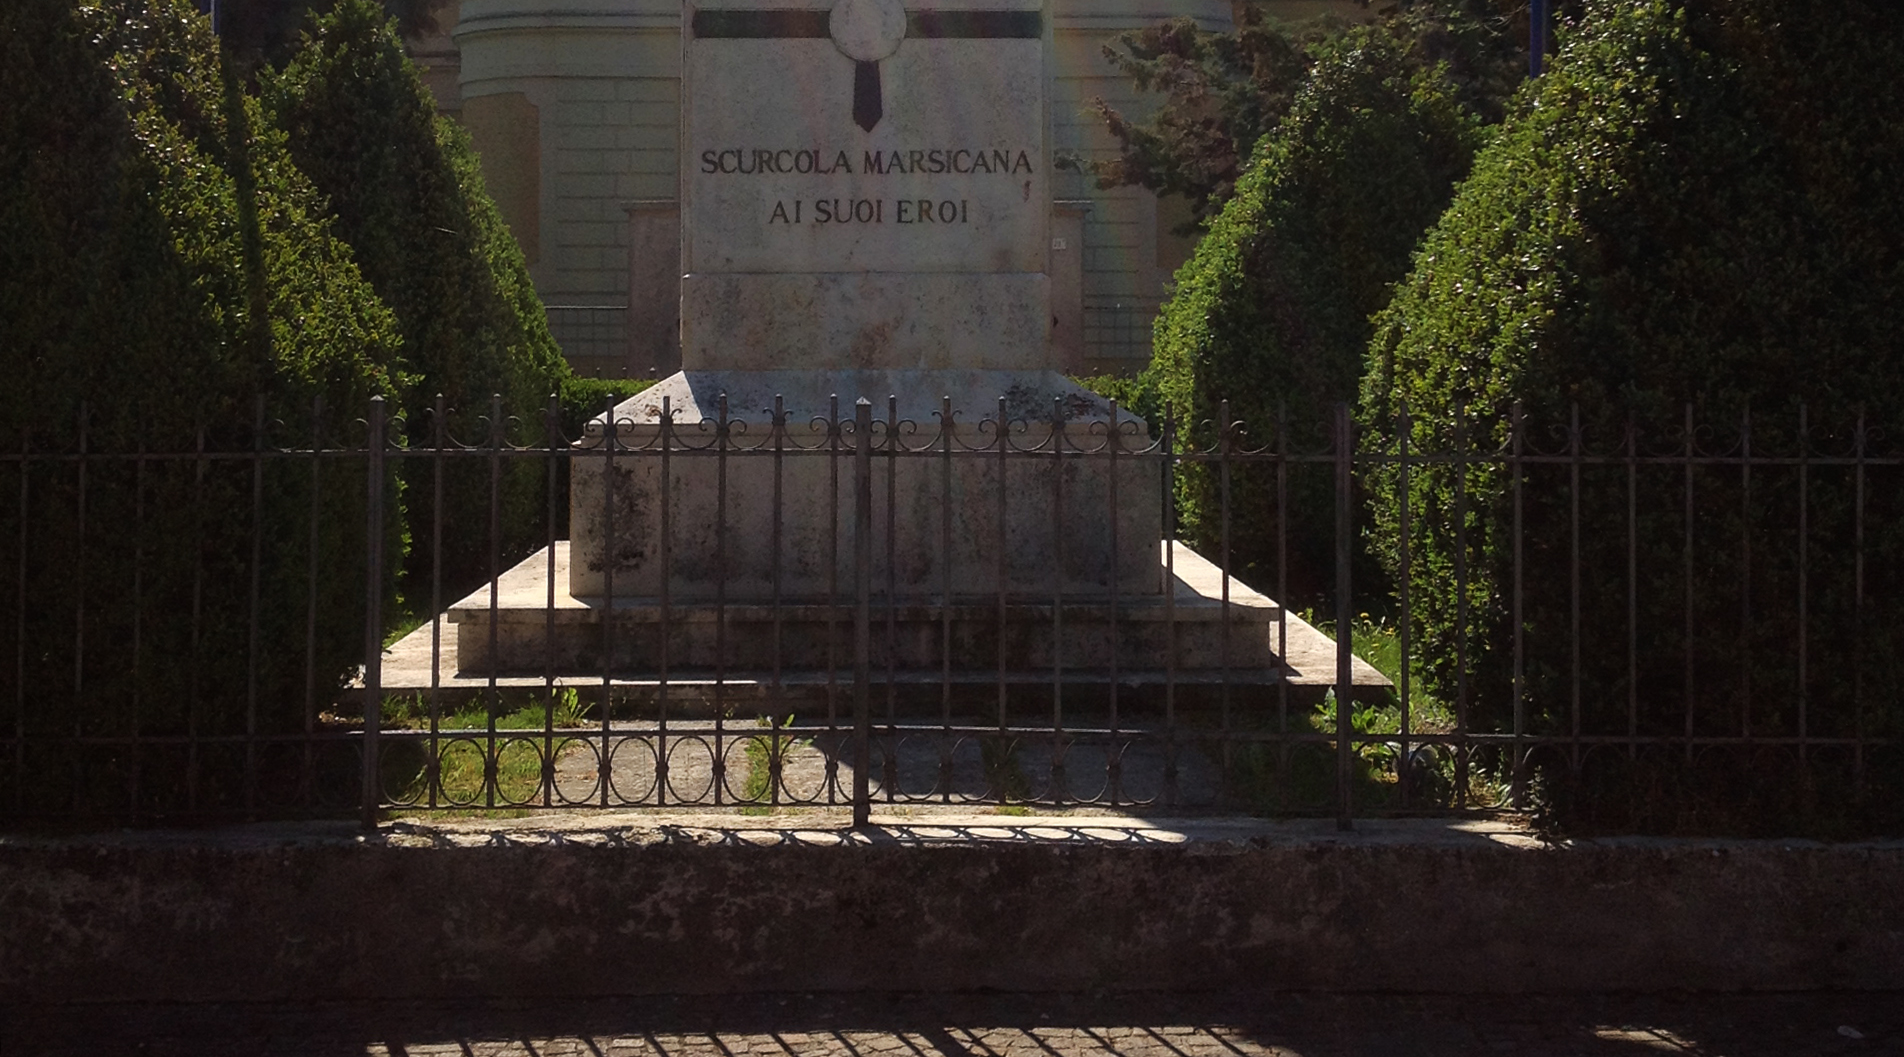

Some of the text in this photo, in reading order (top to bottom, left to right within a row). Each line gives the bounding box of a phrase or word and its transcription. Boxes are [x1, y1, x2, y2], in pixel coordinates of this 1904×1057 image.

[701, 149, 1033, 174] SCURCOLA MARSICANA
[769, 198, 968, 224] AI SUOI EROI
